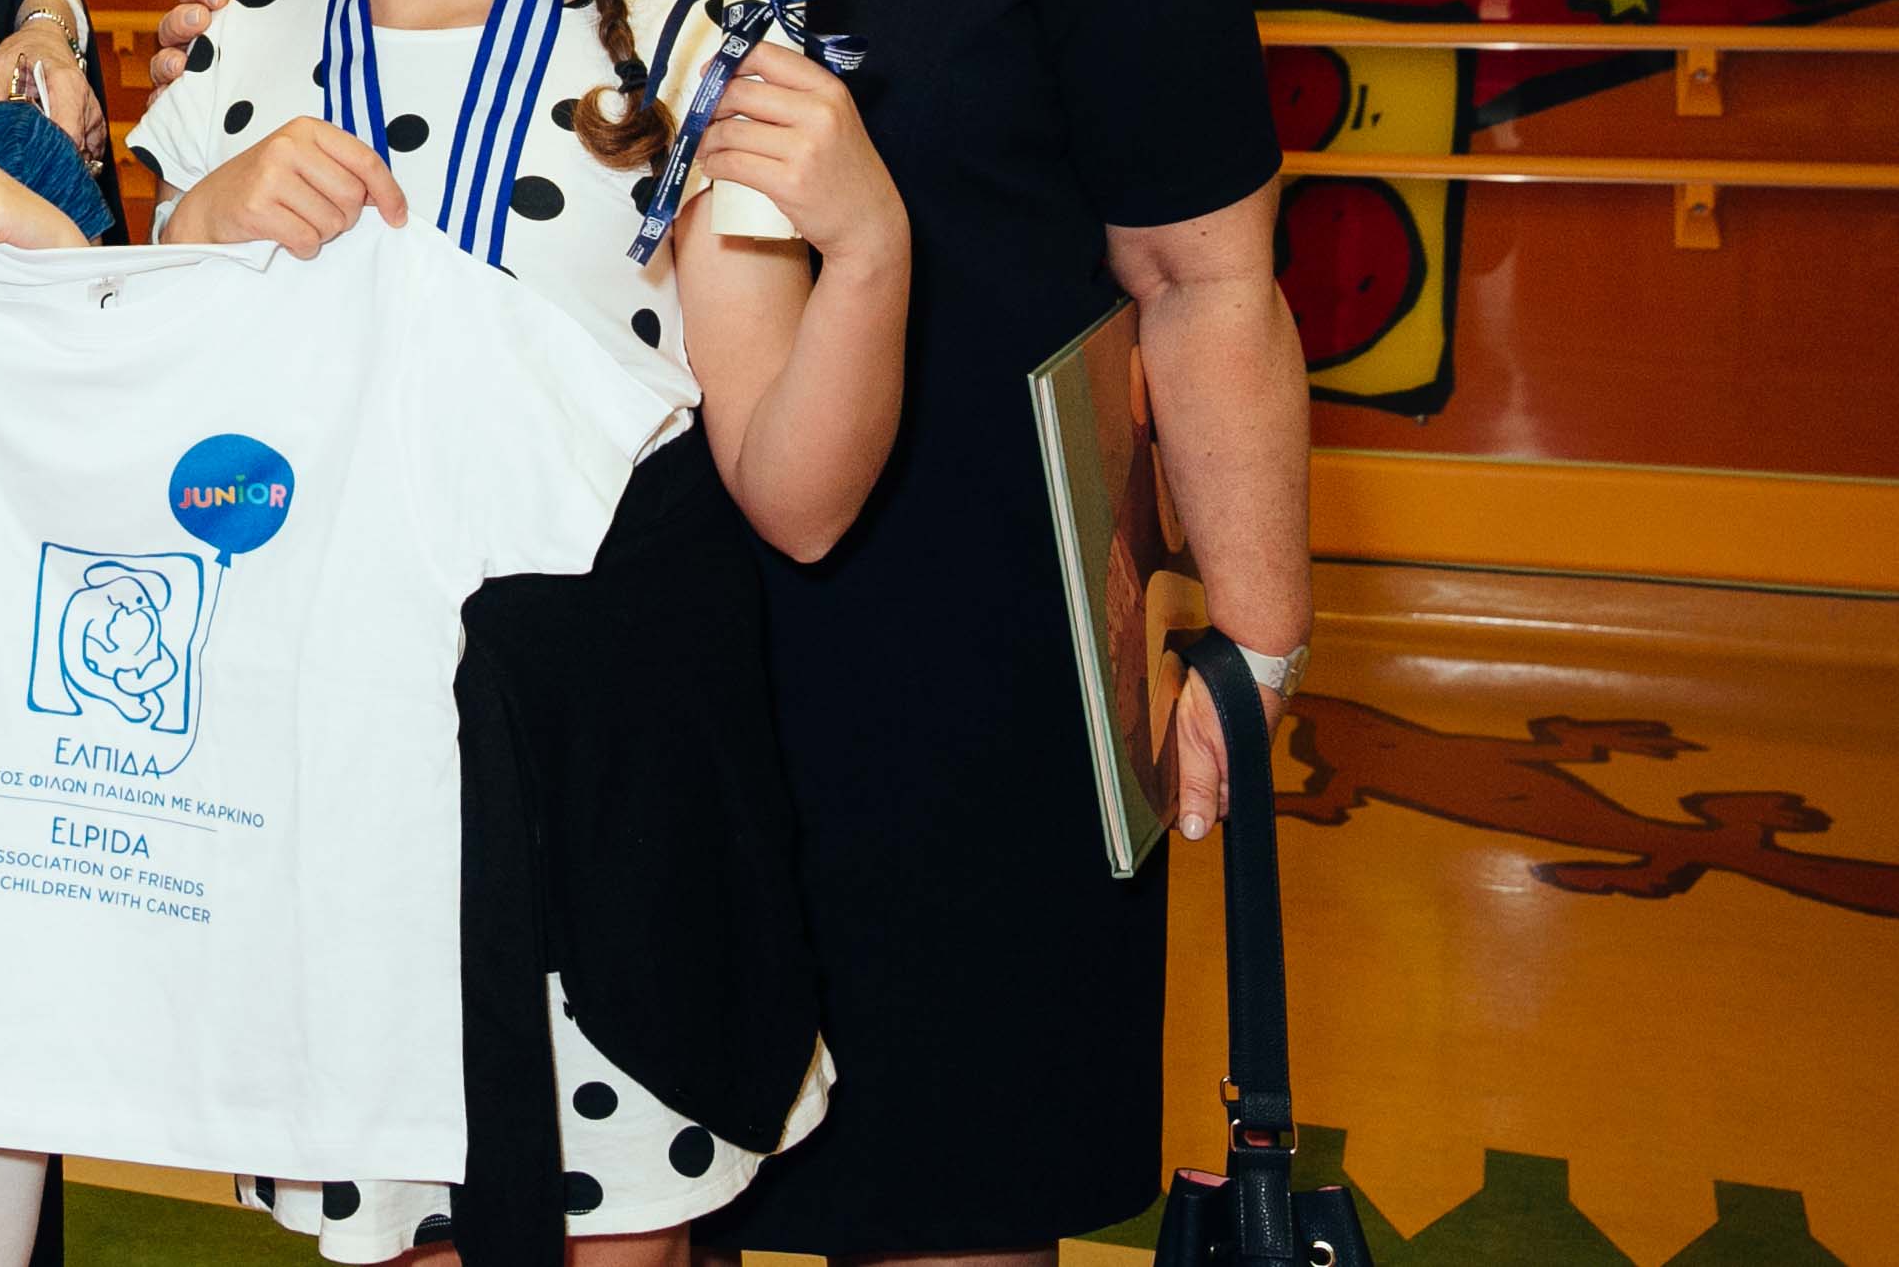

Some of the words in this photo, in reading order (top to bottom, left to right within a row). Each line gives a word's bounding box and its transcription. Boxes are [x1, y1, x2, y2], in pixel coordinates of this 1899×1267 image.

[54, 737, 161, 780] ΕΛΠΙΔΑ
[29, 773, 88, 794] ΦΙΛΩΝ
[93, 783, 166, 807] ΠΑΙΔΙΩΝ
[171, 794, 193, 812] ΜΕ
[196, 801, 265, 828] ΚΑΡΚΙΝΟ
[51, 816, 150, 859] ELPIDA
[0, 875, 92, 901] CHILDREN
[98, 887, 142, 910] WITH
[146, 897, 211, 924] CANCER
[109, 865, 134, 881] OF
[139, 870, 205, 898] FRIENDS
